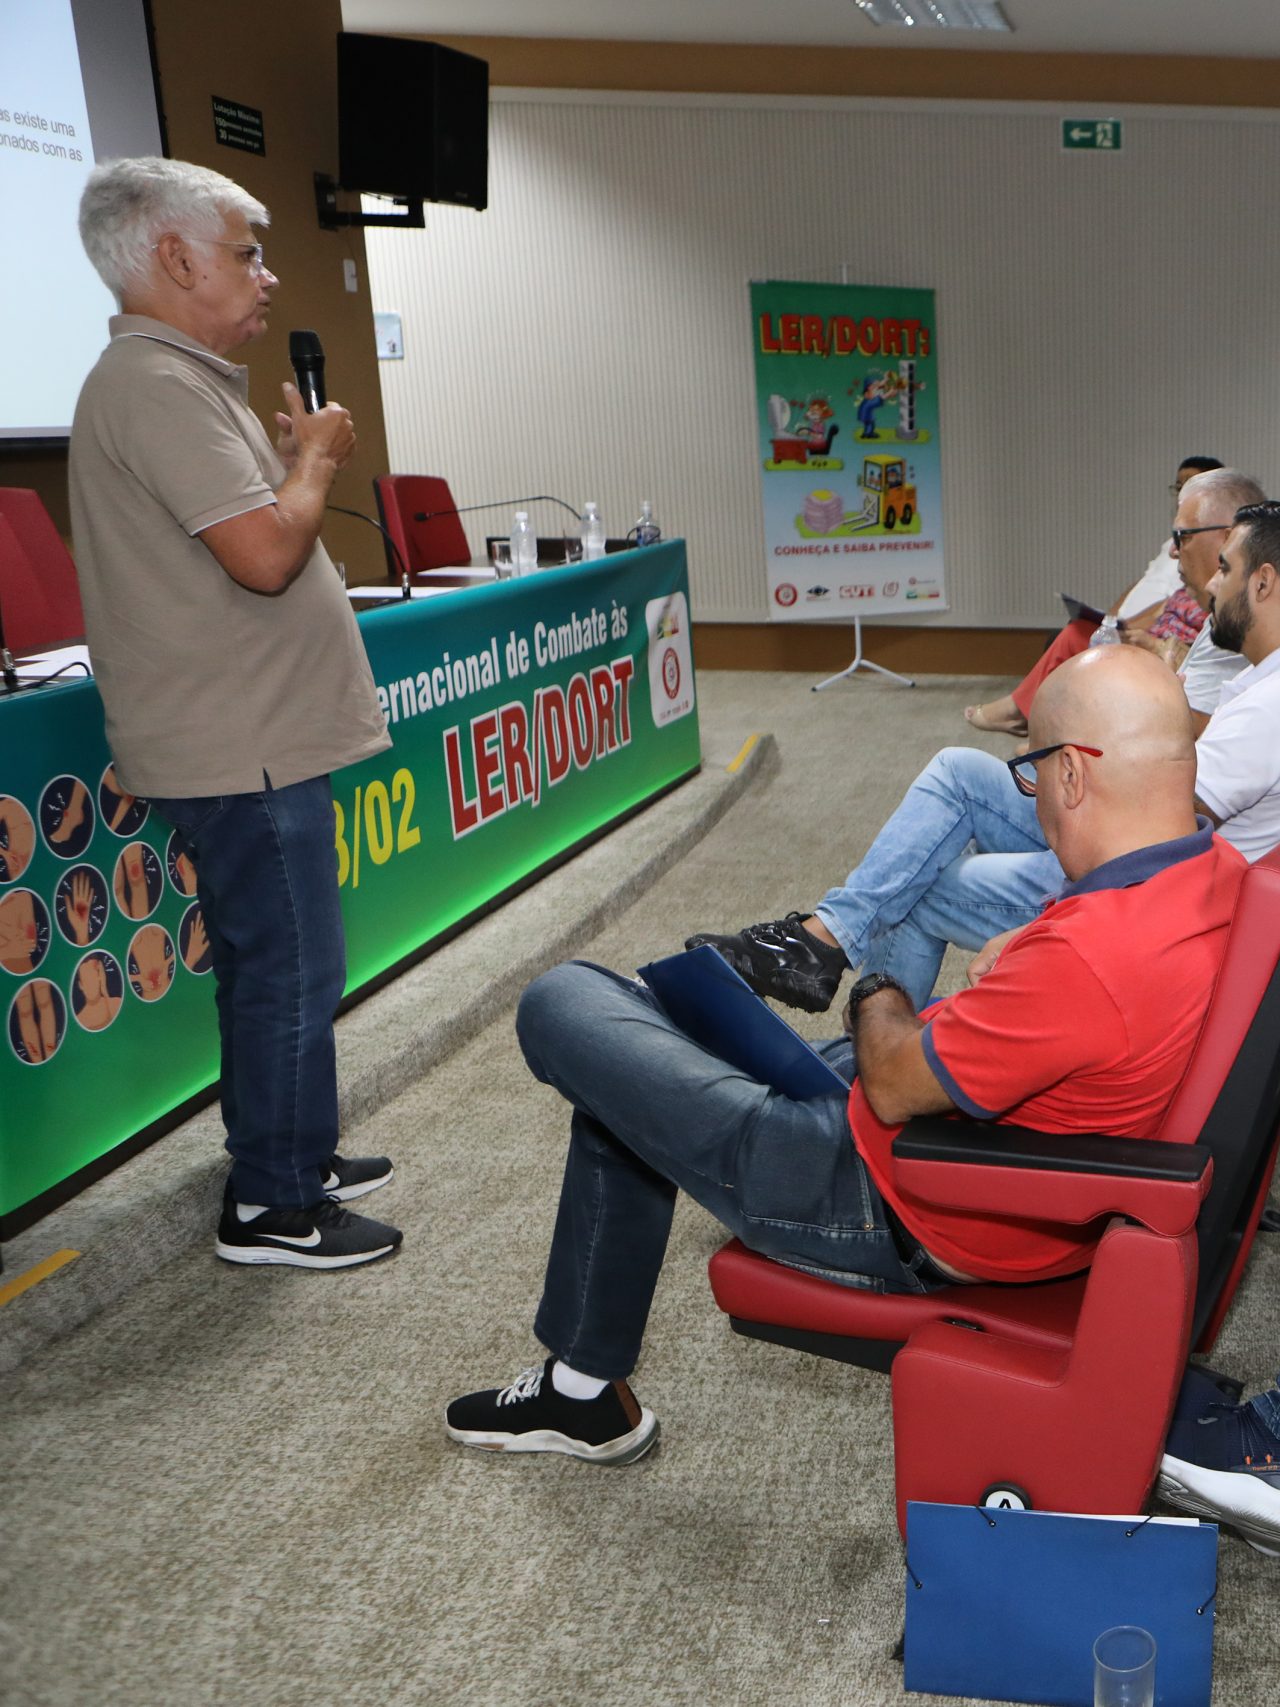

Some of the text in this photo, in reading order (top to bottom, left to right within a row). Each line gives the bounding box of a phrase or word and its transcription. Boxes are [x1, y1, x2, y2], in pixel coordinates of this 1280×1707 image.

[14, 111, 48, 131] existe
[50, 120, 76, 137] uma
[43, 142, 67, 158] com
[69, 148, 83, 161] as
[774, 543, 830, 557] CONHEÇA
[833, 543, 840, 554] E
[844, 542, 876, 554] SAIBA
[376, 600, 628, 725] ernacional de Combate às
[443, 655, 633, 840] LER/DORT
